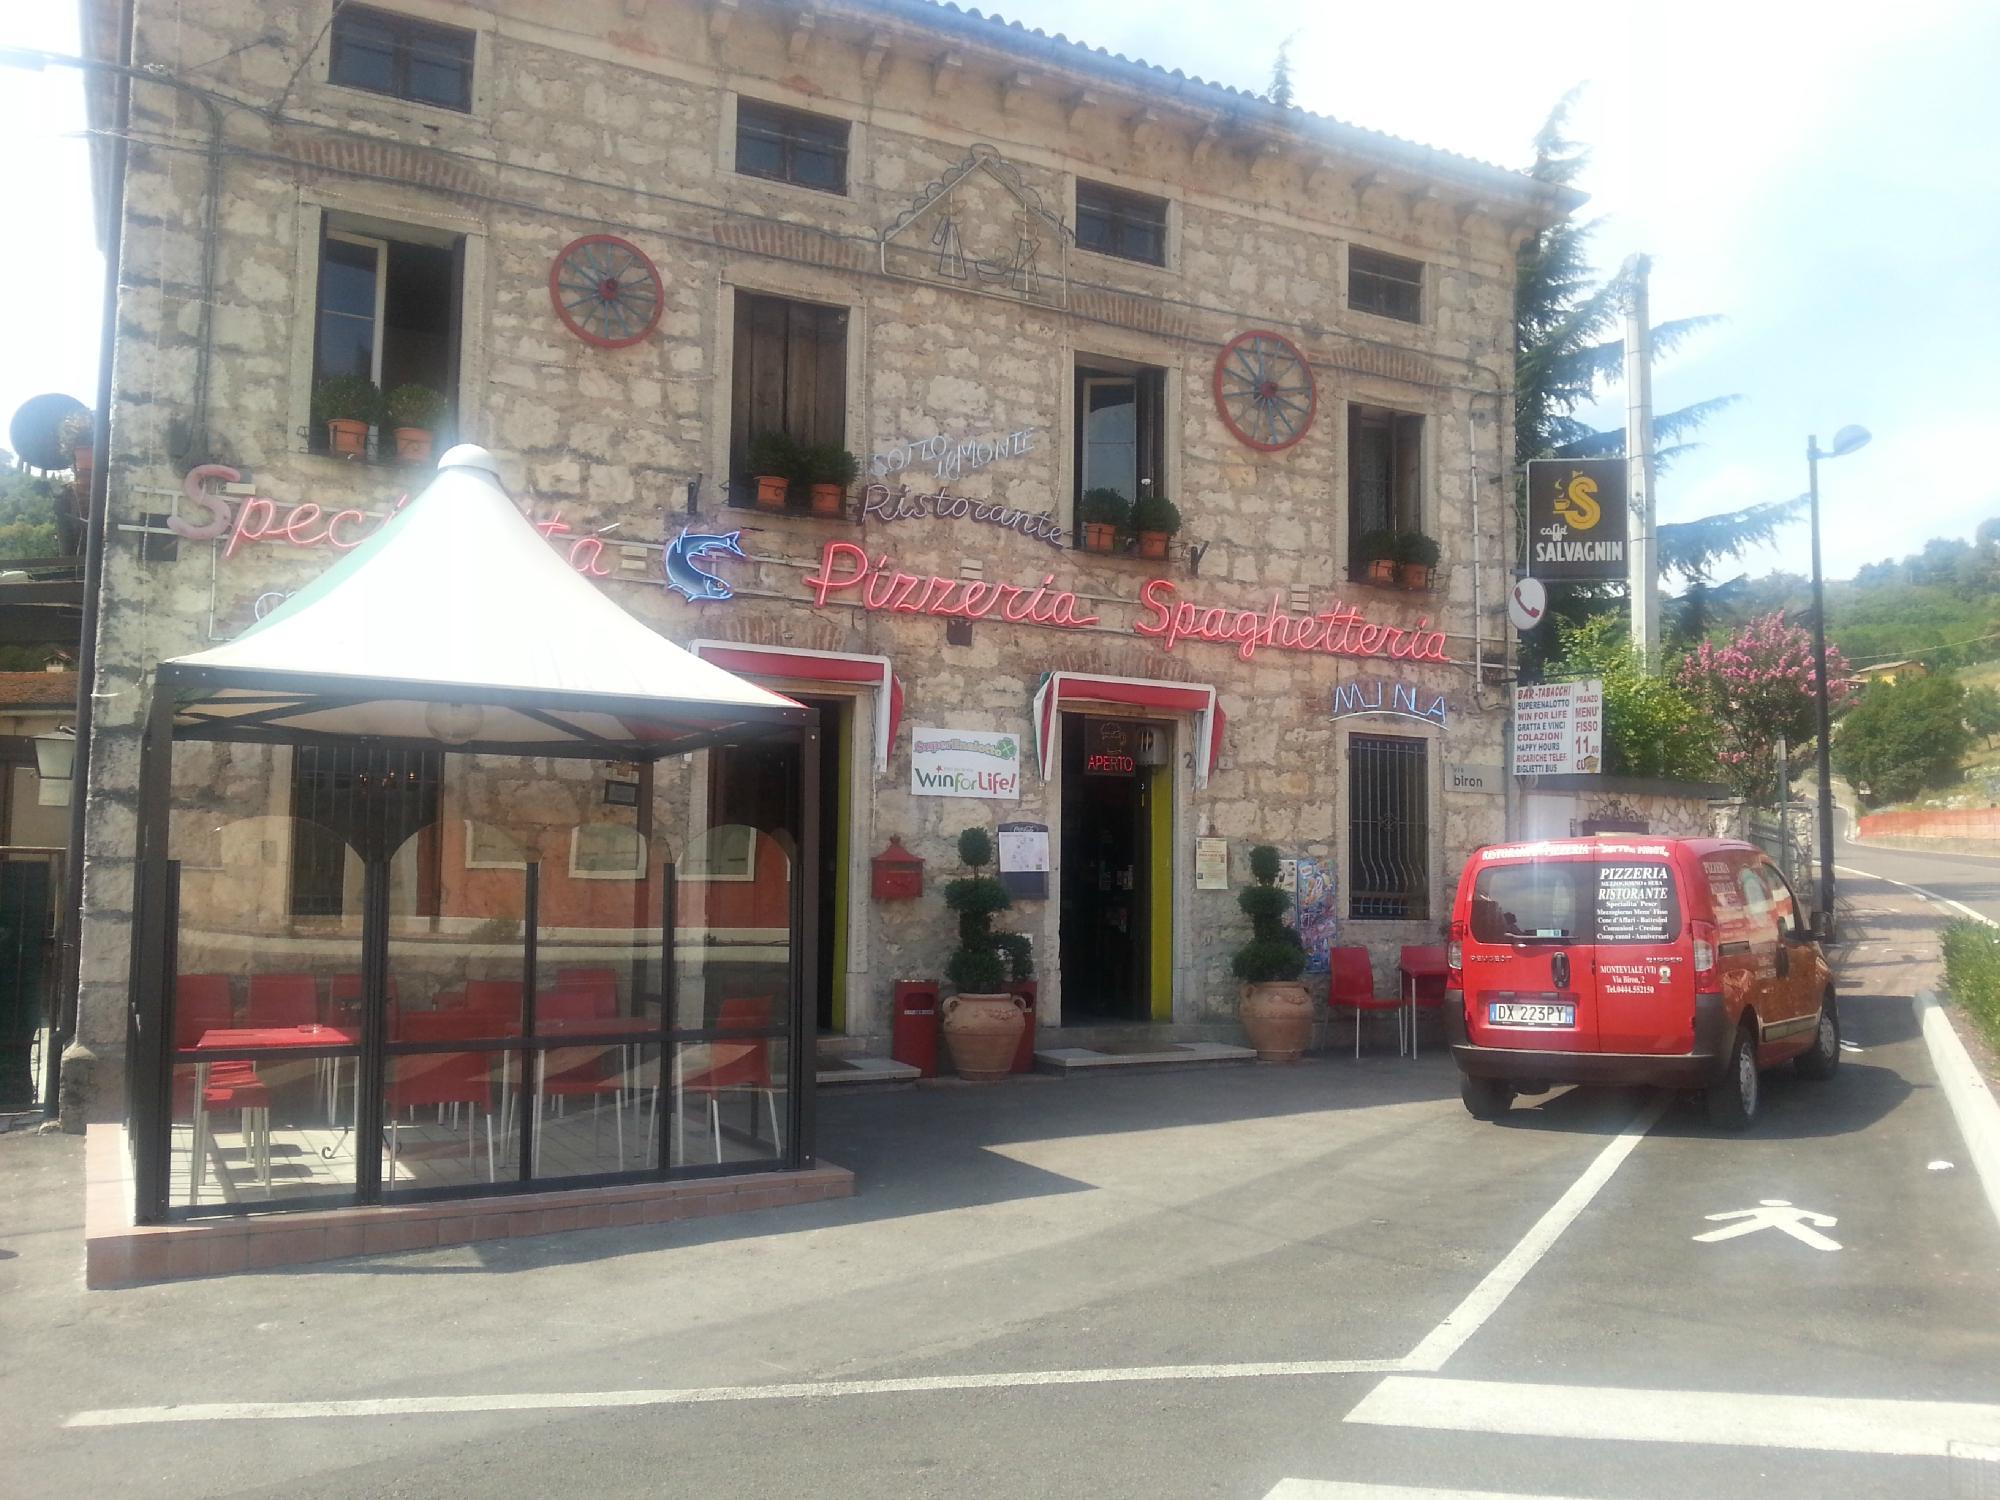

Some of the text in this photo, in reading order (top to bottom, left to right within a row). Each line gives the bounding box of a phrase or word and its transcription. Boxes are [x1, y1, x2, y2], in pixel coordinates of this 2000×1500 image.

[870, 436, 946, 476] SOTTO
[957, 427, 1035, 473] MONTE
[860, 483, 1065, 548] Ristorante
[1536, 541, 1622, 561] SALVAGNIN
[803, 541, 1101, 627] Pizzeria
[1135, 577, 1453, 664] Spaghetteria
[1334, 682, 1446, 724] MINA
[1517, 698, 1570, 710] SUPERENALOTTO
[1576, 695, 1599, 704] PRANZO
[1518, 710, 1567, 721] WIN FOR LIFE
[1517, 721, 1566, 731] GRATTA E VINCI
[1576, 721, 1598, 732] FISSO
[1517, 731, 1563, 742] COLAZIONI
[1516, 742, 1560, 752] HAPPY HOURS
[1088, 754, 1133, 772] APERTO
[1184, 752, 1193, 769] 2
[1454, 775, 1483, 787] biron
[1600, 867, 1668, 880] PIZZERIA
[1598, 887, 1668, 900] RISTORANTE
[1600, 965, 1643, 974] MONTEVIALE
[1612, 975, 1623, 983] Via
[1498, 1005, 1514, 1020] DX
[1520, 1006, 1564, 1021] 223PY
